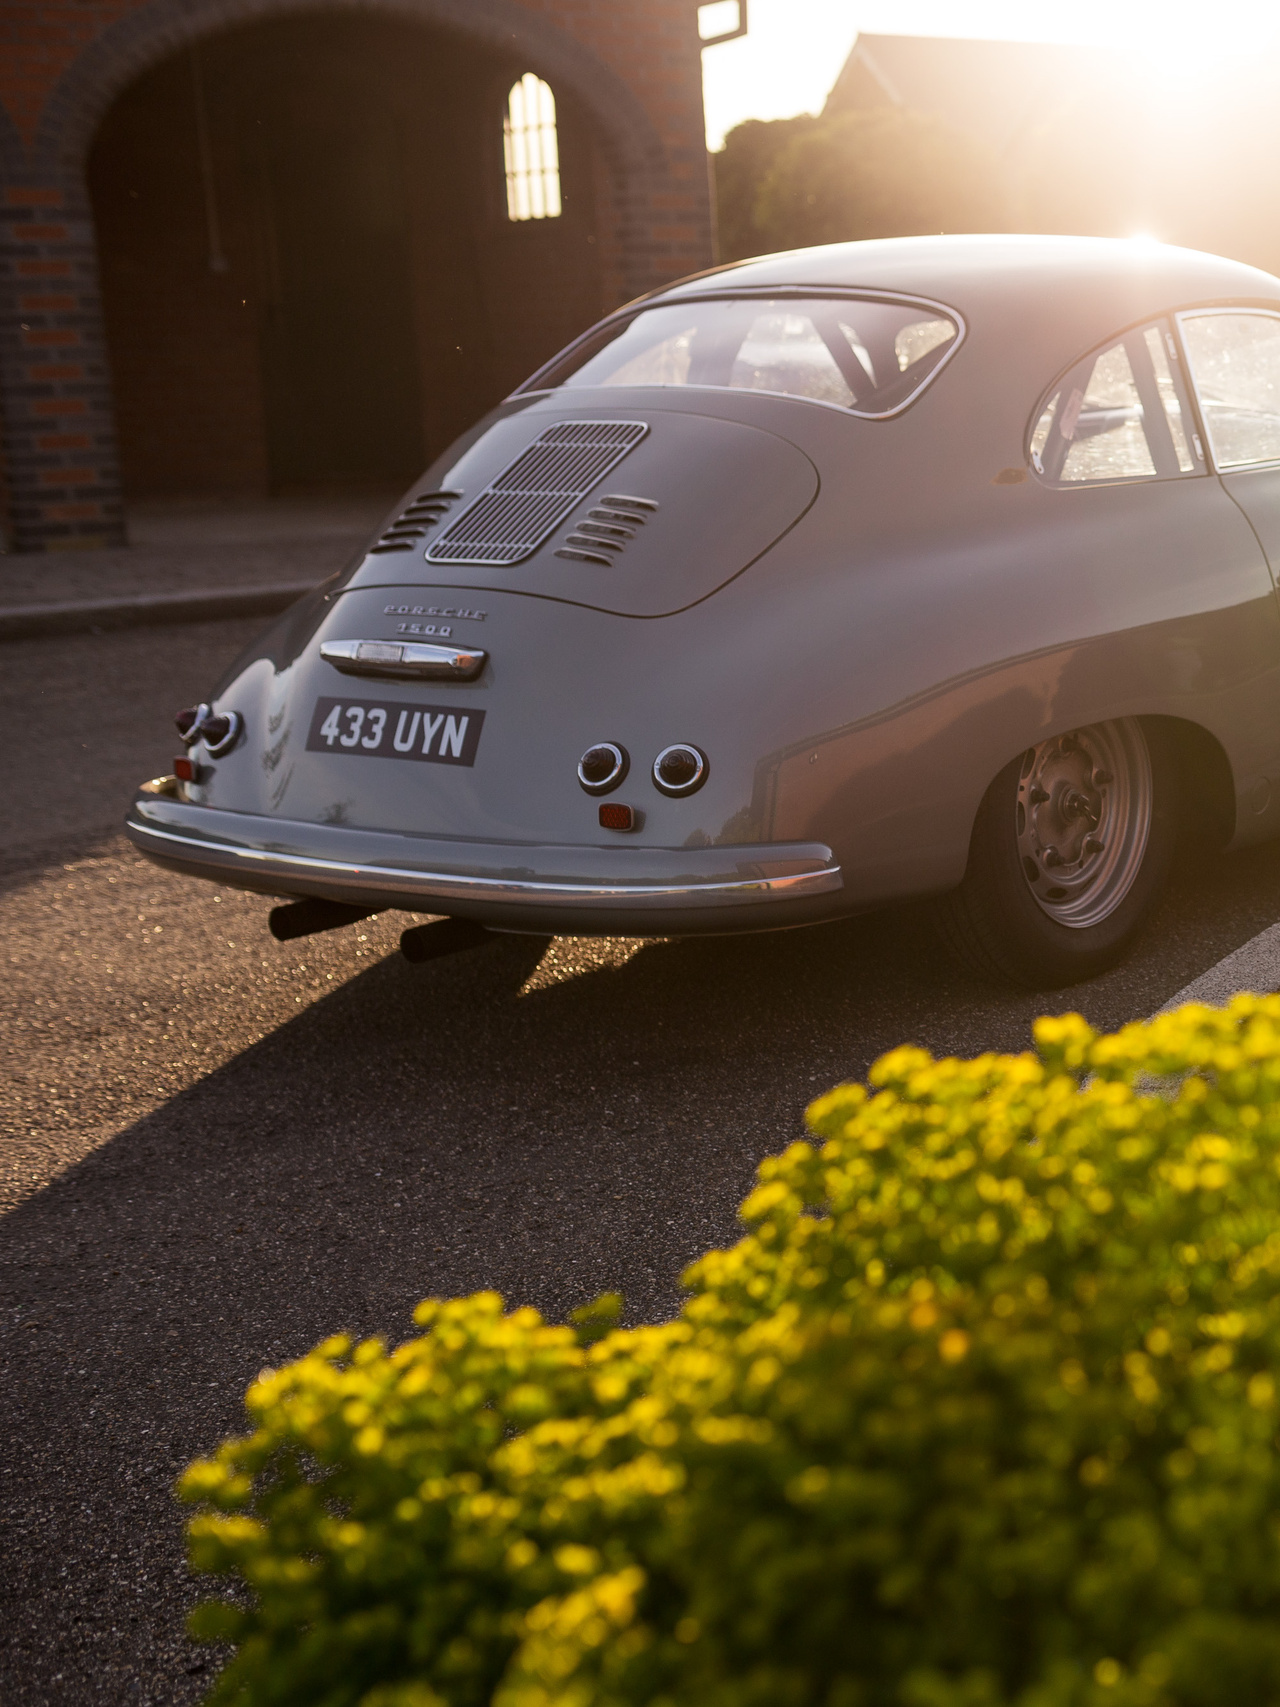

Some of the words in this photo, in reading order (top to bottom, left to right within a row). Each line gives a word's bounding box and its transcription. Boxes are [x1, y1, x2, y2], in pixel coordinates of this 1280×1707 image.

[384, 604, 487, 621] PORSCHE
[397, 623, 452, 637] 1500
[320, 705, 387, 749] 433
[393, 710, 469, 758] UYN
